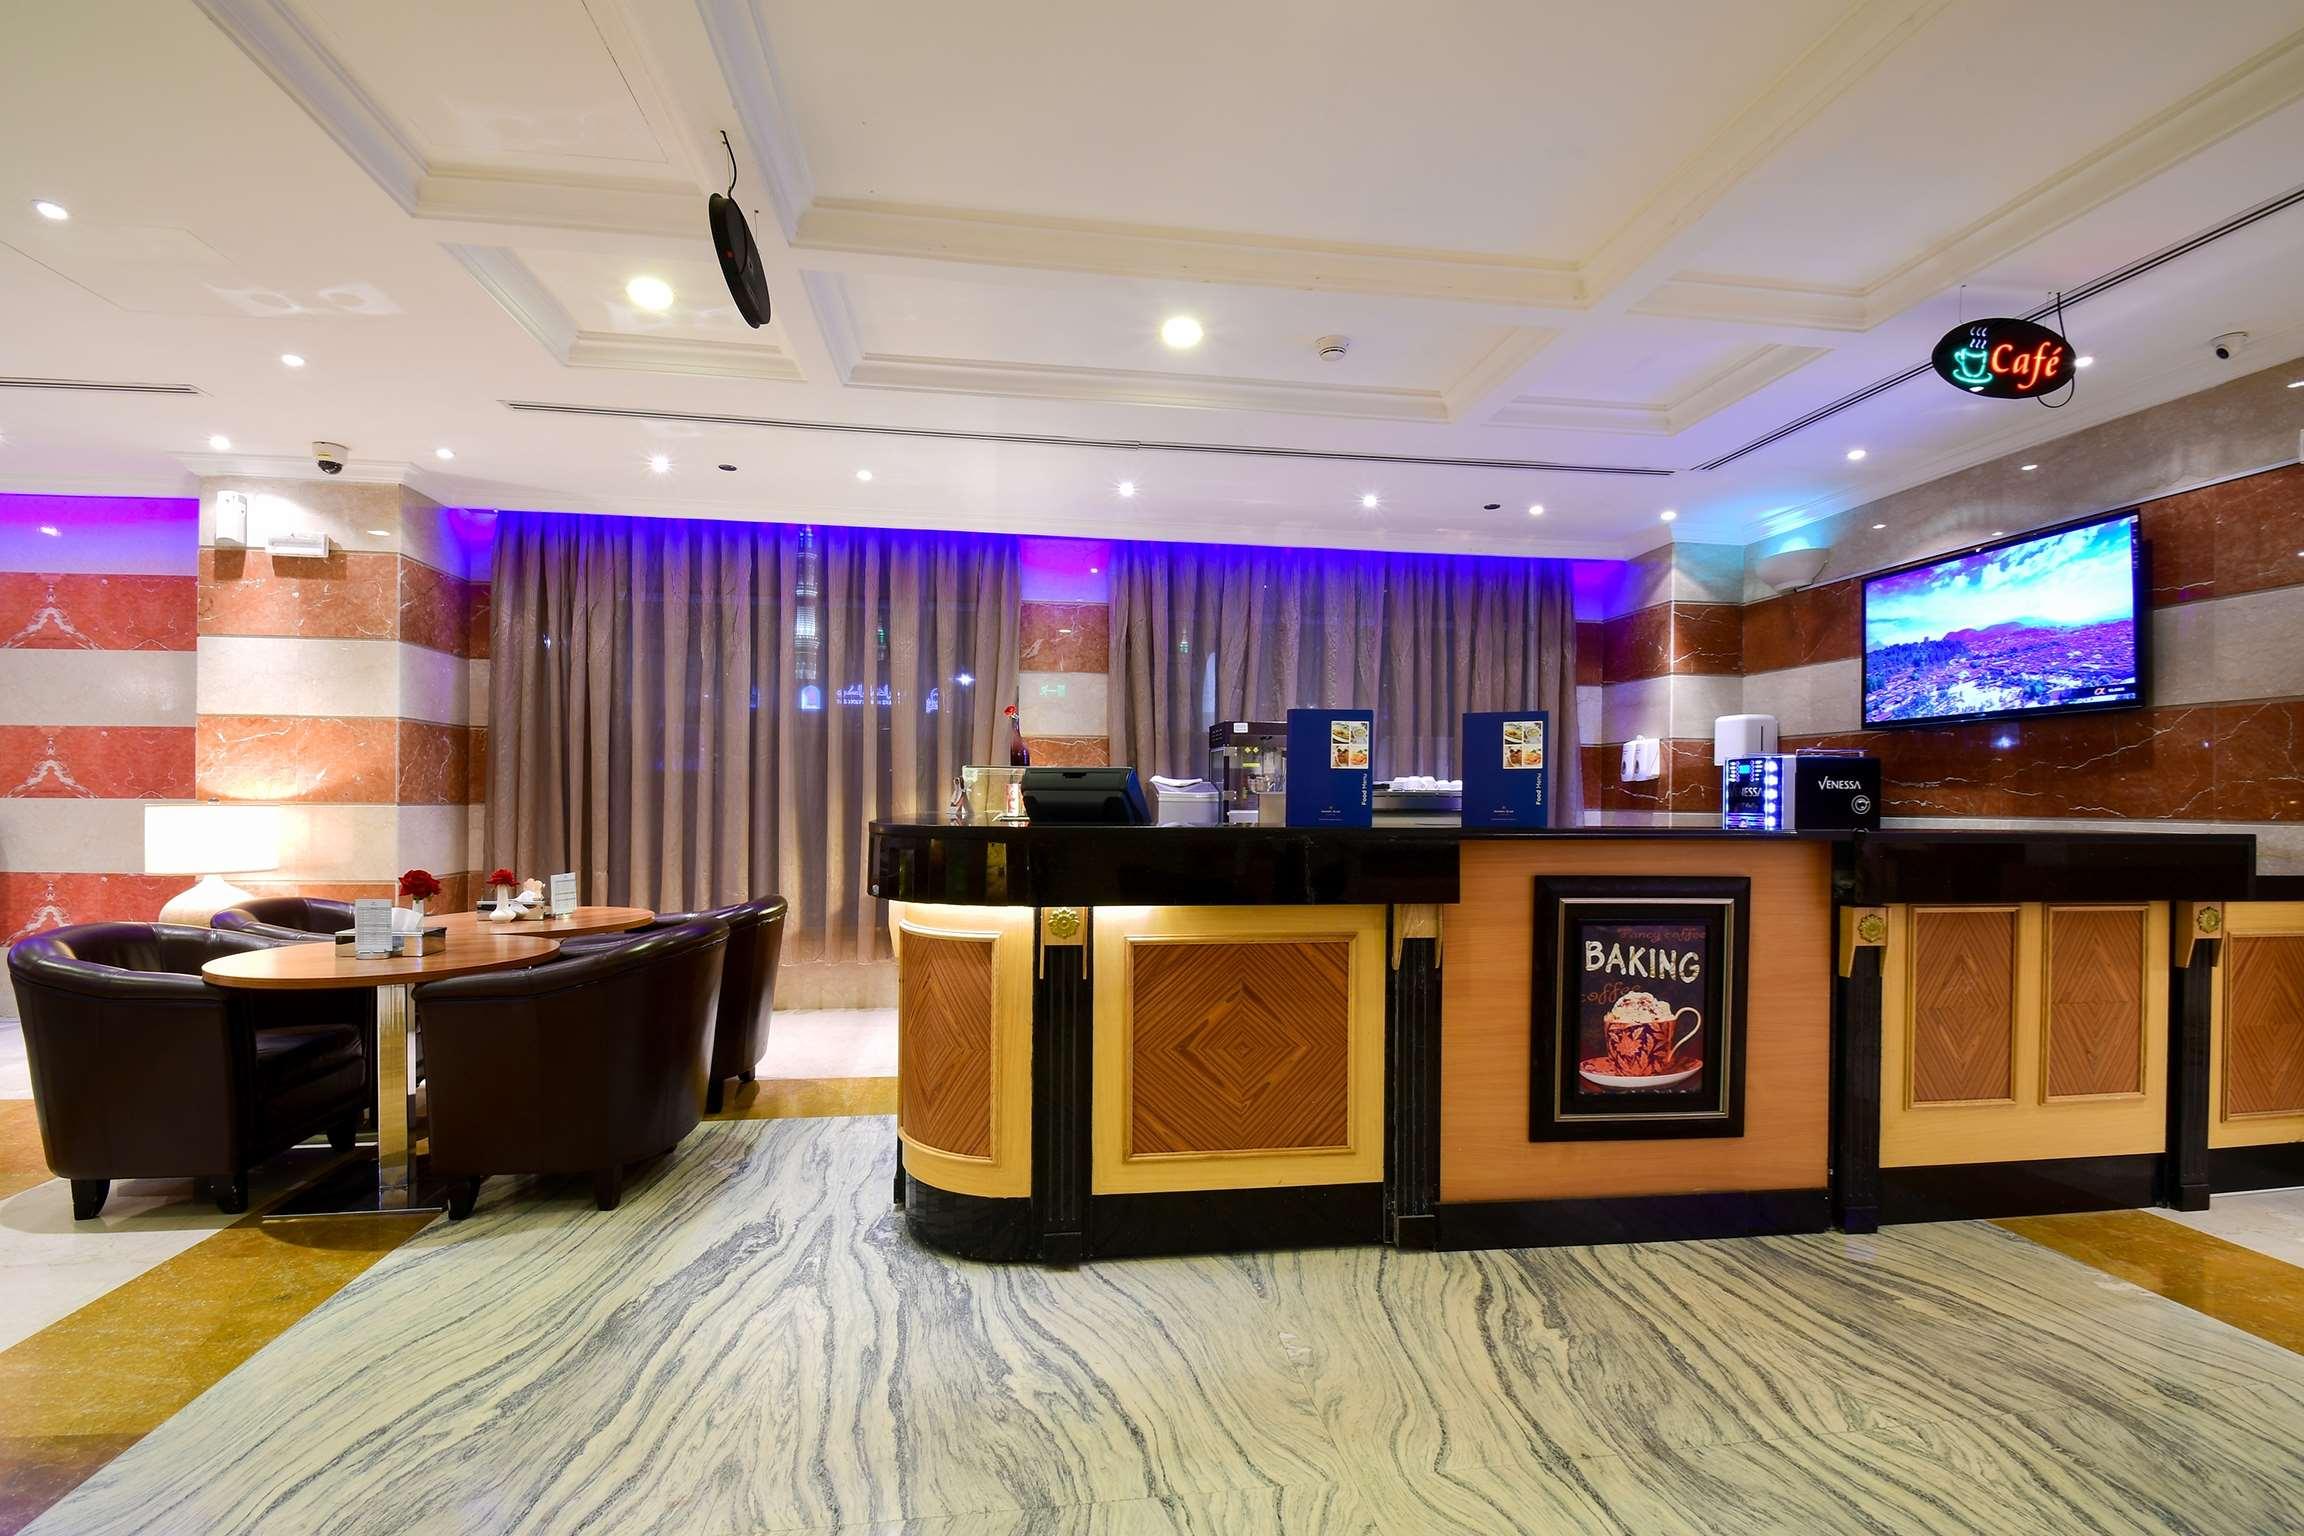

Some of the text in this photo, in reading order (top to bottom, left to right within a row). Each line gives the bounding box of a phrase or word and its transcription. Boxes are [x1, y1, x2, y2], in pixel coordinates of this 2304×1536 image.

[1991, 341, 2063, 390] Café
[1817, 775, 1862, 790] VENESSA
[1585, 940, 1701, 983] BAKING
